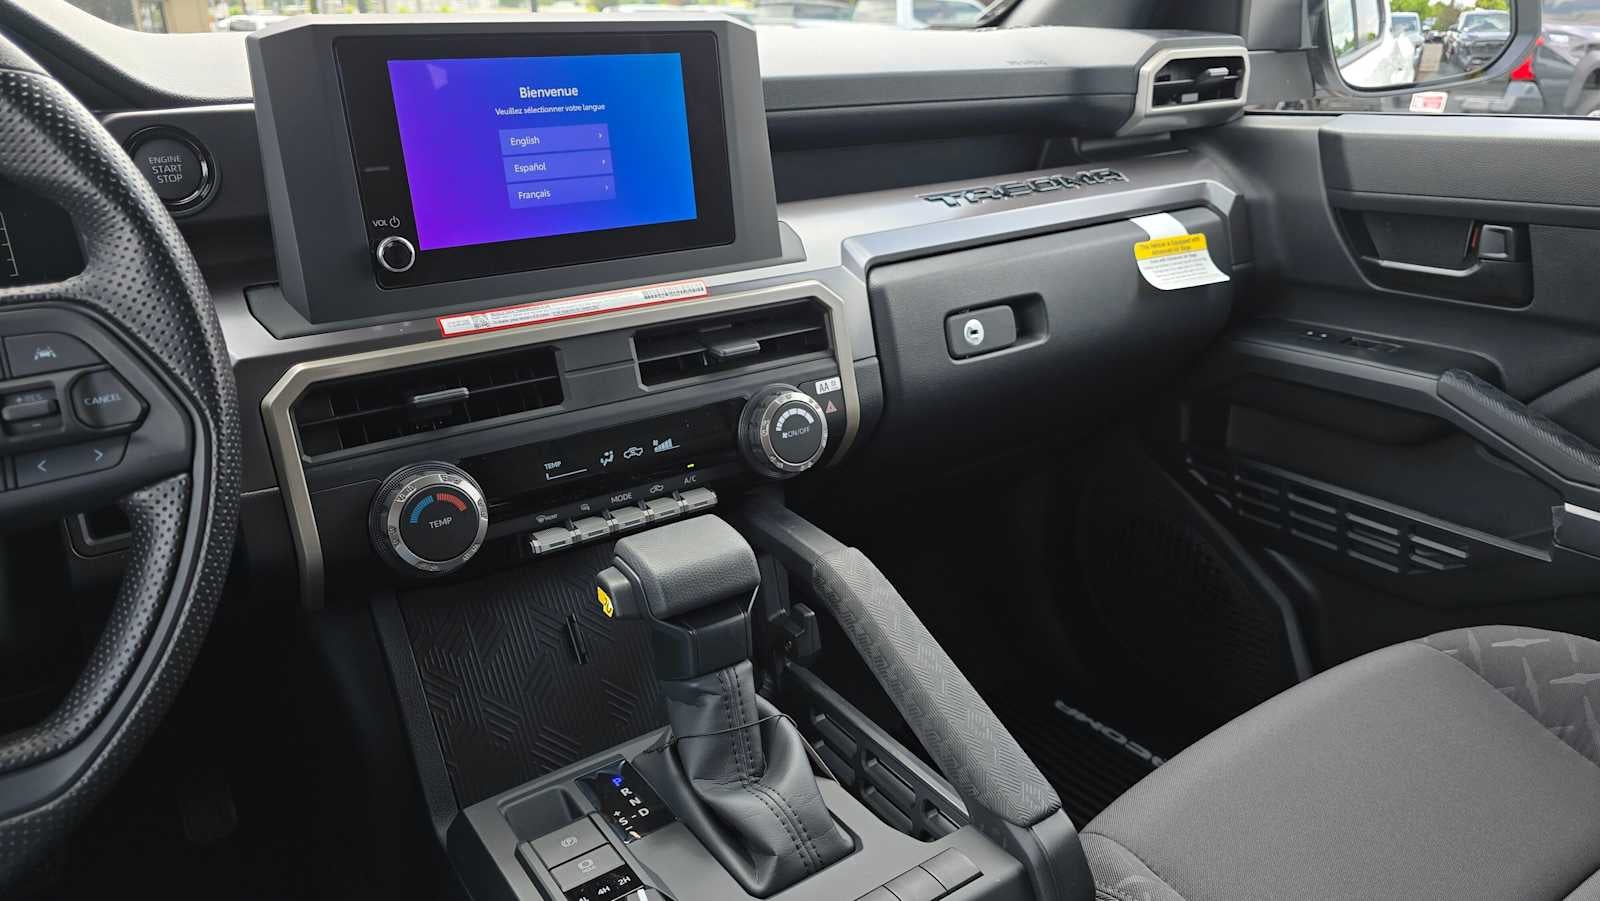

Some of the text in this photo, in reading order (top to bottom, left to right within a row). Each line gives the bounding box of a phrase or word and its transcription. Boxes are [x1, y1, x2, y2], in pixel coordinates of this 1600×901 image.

[519, 86, 578, 99] Bienvenue
[495, 103, 605, 116] Veuillez sélectionner votre langue
[510, 136, 540, 147] English
[148, 155, 183, 164] ENGINE
[152, 164, 183, 174] START
[514, 162, 546, 174] Español
[157, 173, 183, 184] STOP
[916, 167, 1129, 208] TACOMA
[518, 189, 551, 200] Français
[372, 219, 388, 227] VOL
[84, 393, 121, 406] CANCEL
[544, 460, 562, 470] TEMP
[684, 475, 697, 485] A/C
[611, 491, 633, 504] MODE
[428, 516, 453, 529] TEMP
[612, 776, 622, 787] P
[620, 787, 632, 797] R
[629, 797, 641, 806] N
[638, 807, 650, 817] D
[618, 816, 629, 826] S
[617, 875, 632, 886] 2H
[597, 885, 611, 896] 4H
